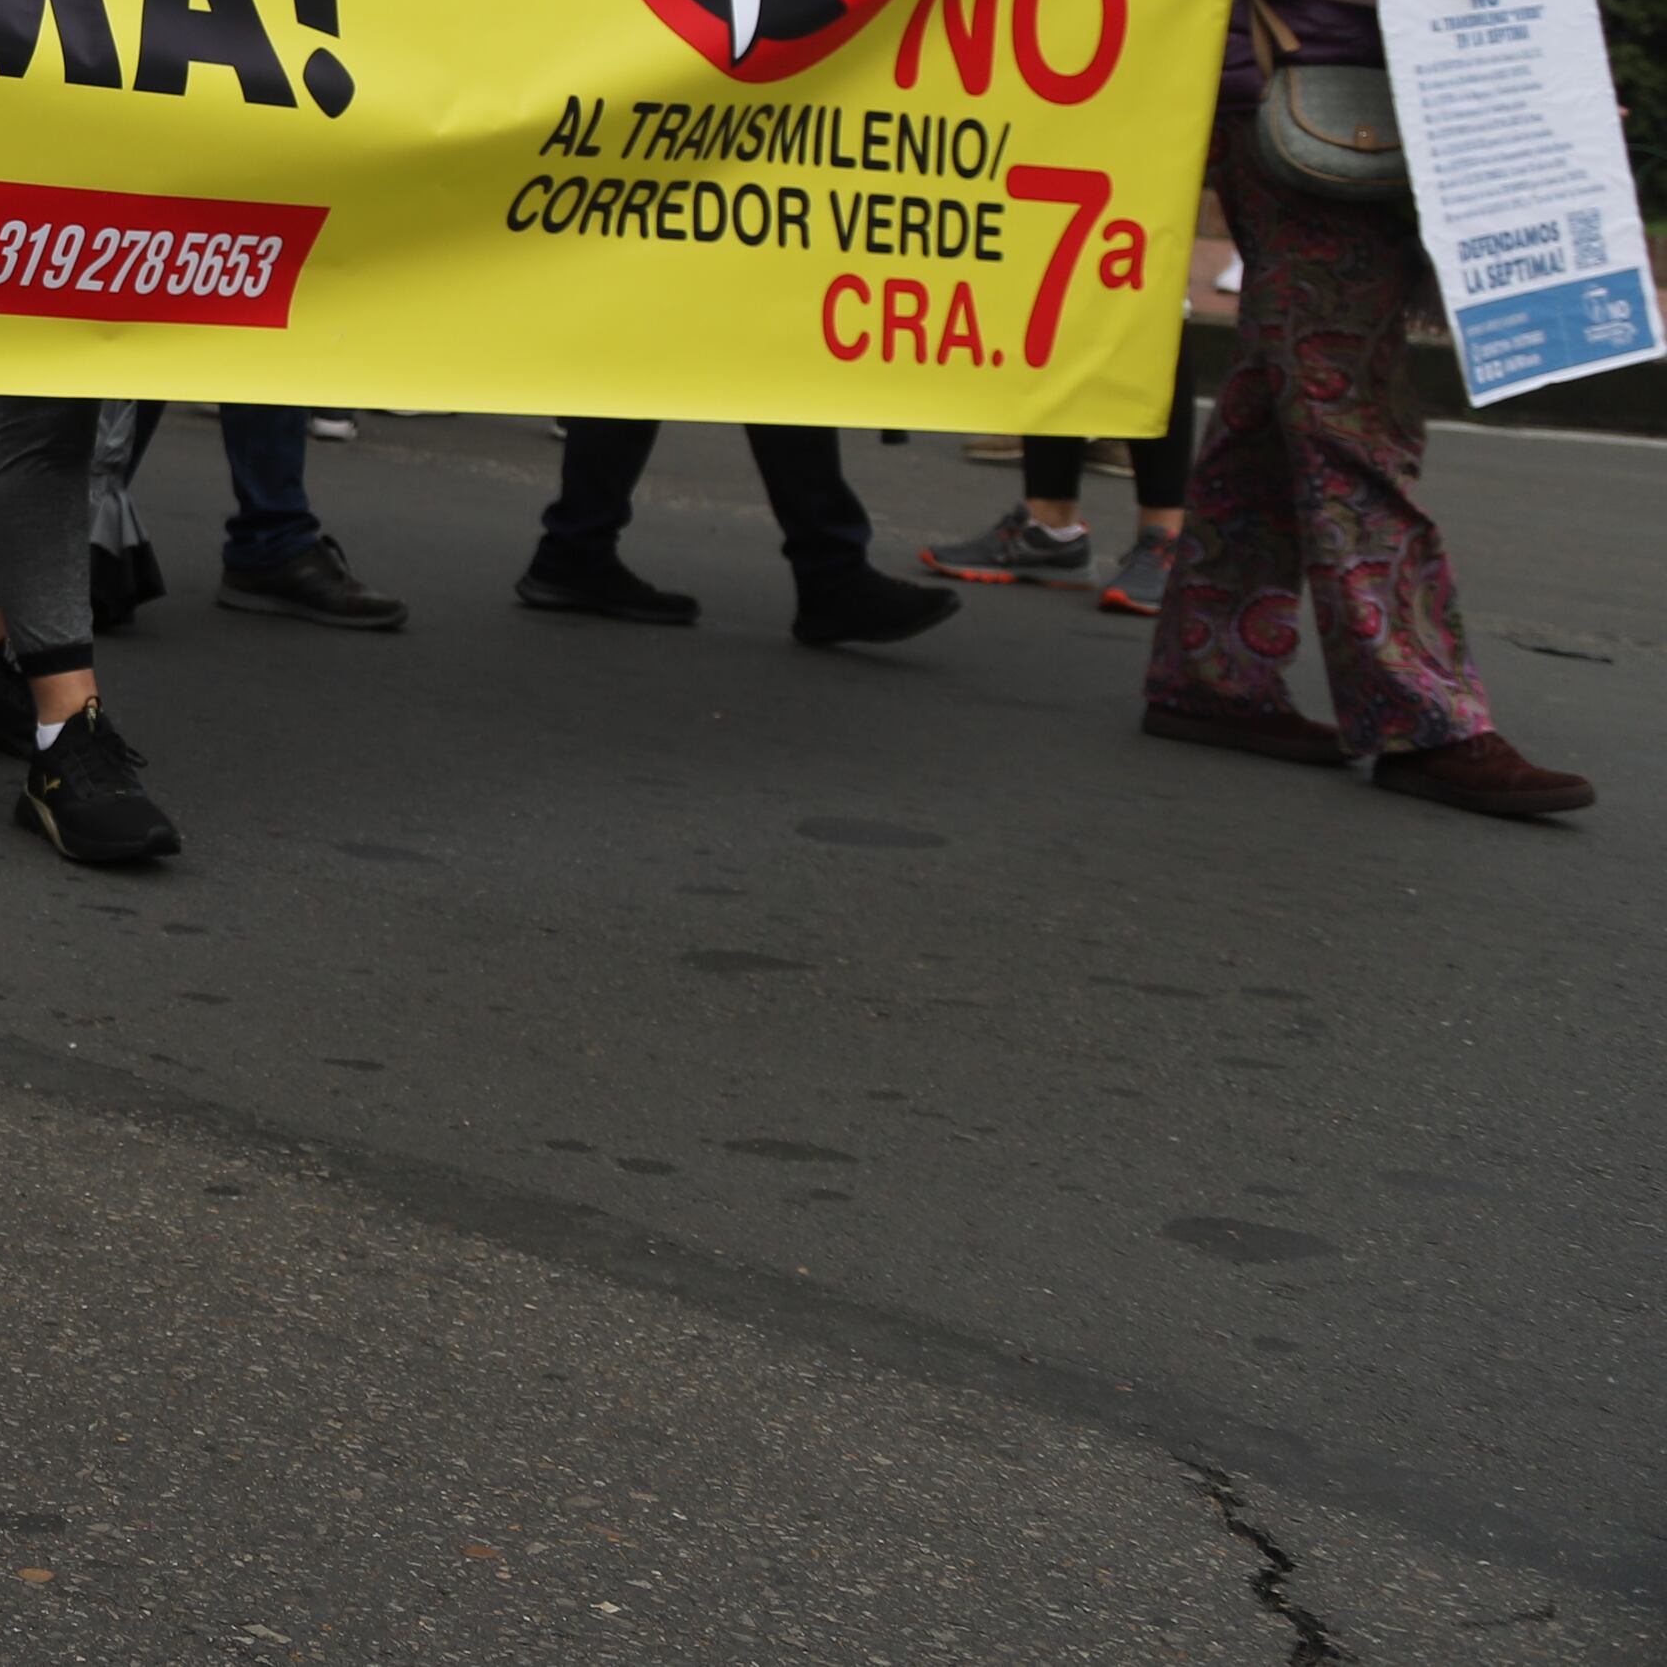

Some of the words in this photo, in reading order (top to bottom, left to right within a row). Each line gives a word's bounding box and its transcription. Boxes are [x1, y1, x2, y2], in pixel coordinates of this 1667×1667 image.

[539, 95, 604, 157] AL
[621, 101, 1011, 181] TRANSMILENIO/
[506, 174, 810, 249] CORREDOR
[829, 189, 1005, 261] VERDE
